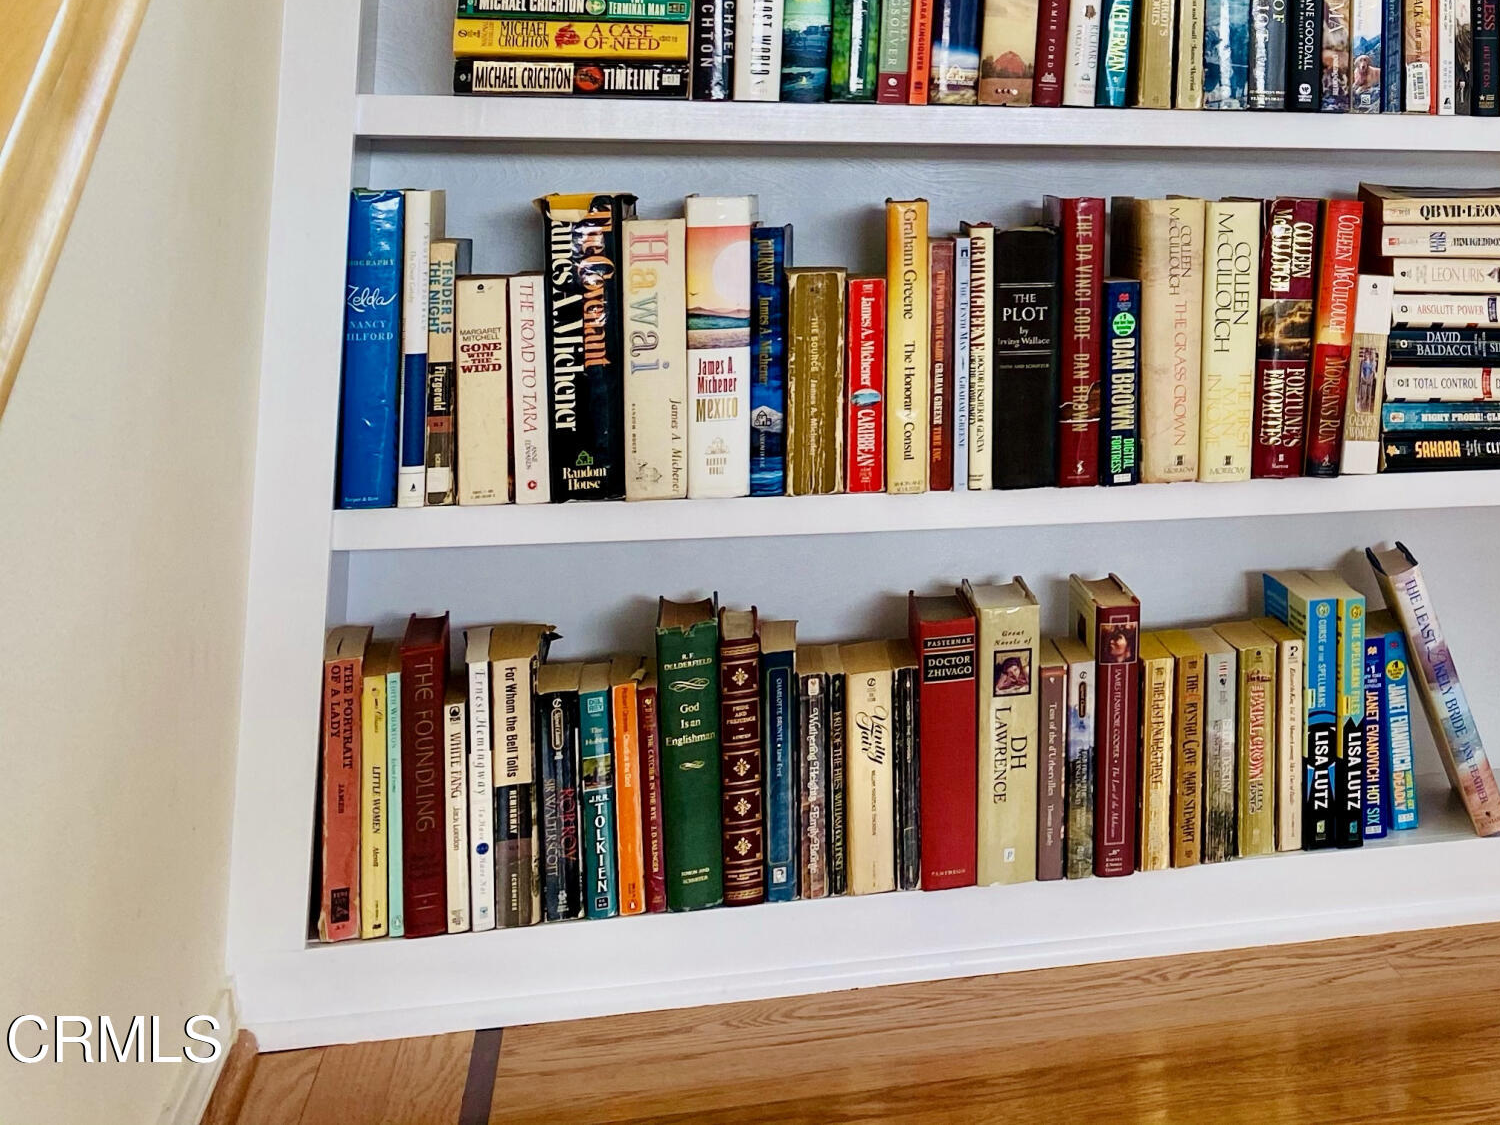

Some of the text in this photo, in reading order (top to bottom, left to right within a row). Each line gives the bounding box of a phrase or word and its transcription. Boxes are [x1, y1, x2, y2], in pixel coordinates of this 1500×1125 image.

[500, 22, 548, 35] MICHAEL
[591, 23, 653, 37] A CASE
[498, 34, 549, 48] CRICHTON
[584, 37, 660, 51] OF NEED
[474, 66, 570, 89] MICHAEL CRICHTON
[604, 68, 660, 89] TIMELINE
[1074, 214, 1092, 340] THE DA VINCI CODE
[347, 285, 397, 312] Zelda
[1013, 294, 1036, 303] THE
[1003, 306, 1048, 322] PLOT
[1426, 332, 1460, 343] DAVID
[460, 343, 502, 353] GONE
[1416, 343, 1472, 355] BALDACCI
[460, 362, 502, 373] WIND
[470, 357, 492, 365] THE
[698, 356, 736, 374] James A.
[698, 377, 737, 394] Michener
[1111, 338, 1135, 431] DAN BROWN
[696, 397, 738, 422] Mexico
[857, 409, 876, 467] CARIBBEAN
[1415, 441, 1460, 457] SAHARA
[927, 637, 972, 647] PASTERNAK
[928, 656, 970, 667] DOCTOR
[928, 666, 972, 677] ZHIVAGO
[680, 703, 699, 713] God
[504, 667, 518, 777] For Whom the Bell Tolls
[681, 718, 700, 728] Is an
[414, 657, 436, 833] THE FOUNDLING
[666, 732, 715, 747] Englishman
[993, 705, 1012, 804] LAWRENCE
[1010, 735, 1028, 771] DH
[1314, 730, 1328, 809] LISA LUTZ
[1347, 732, 1361, 810] LISA LUTZ
[594, 805, 607, 893] TOLKIEN
